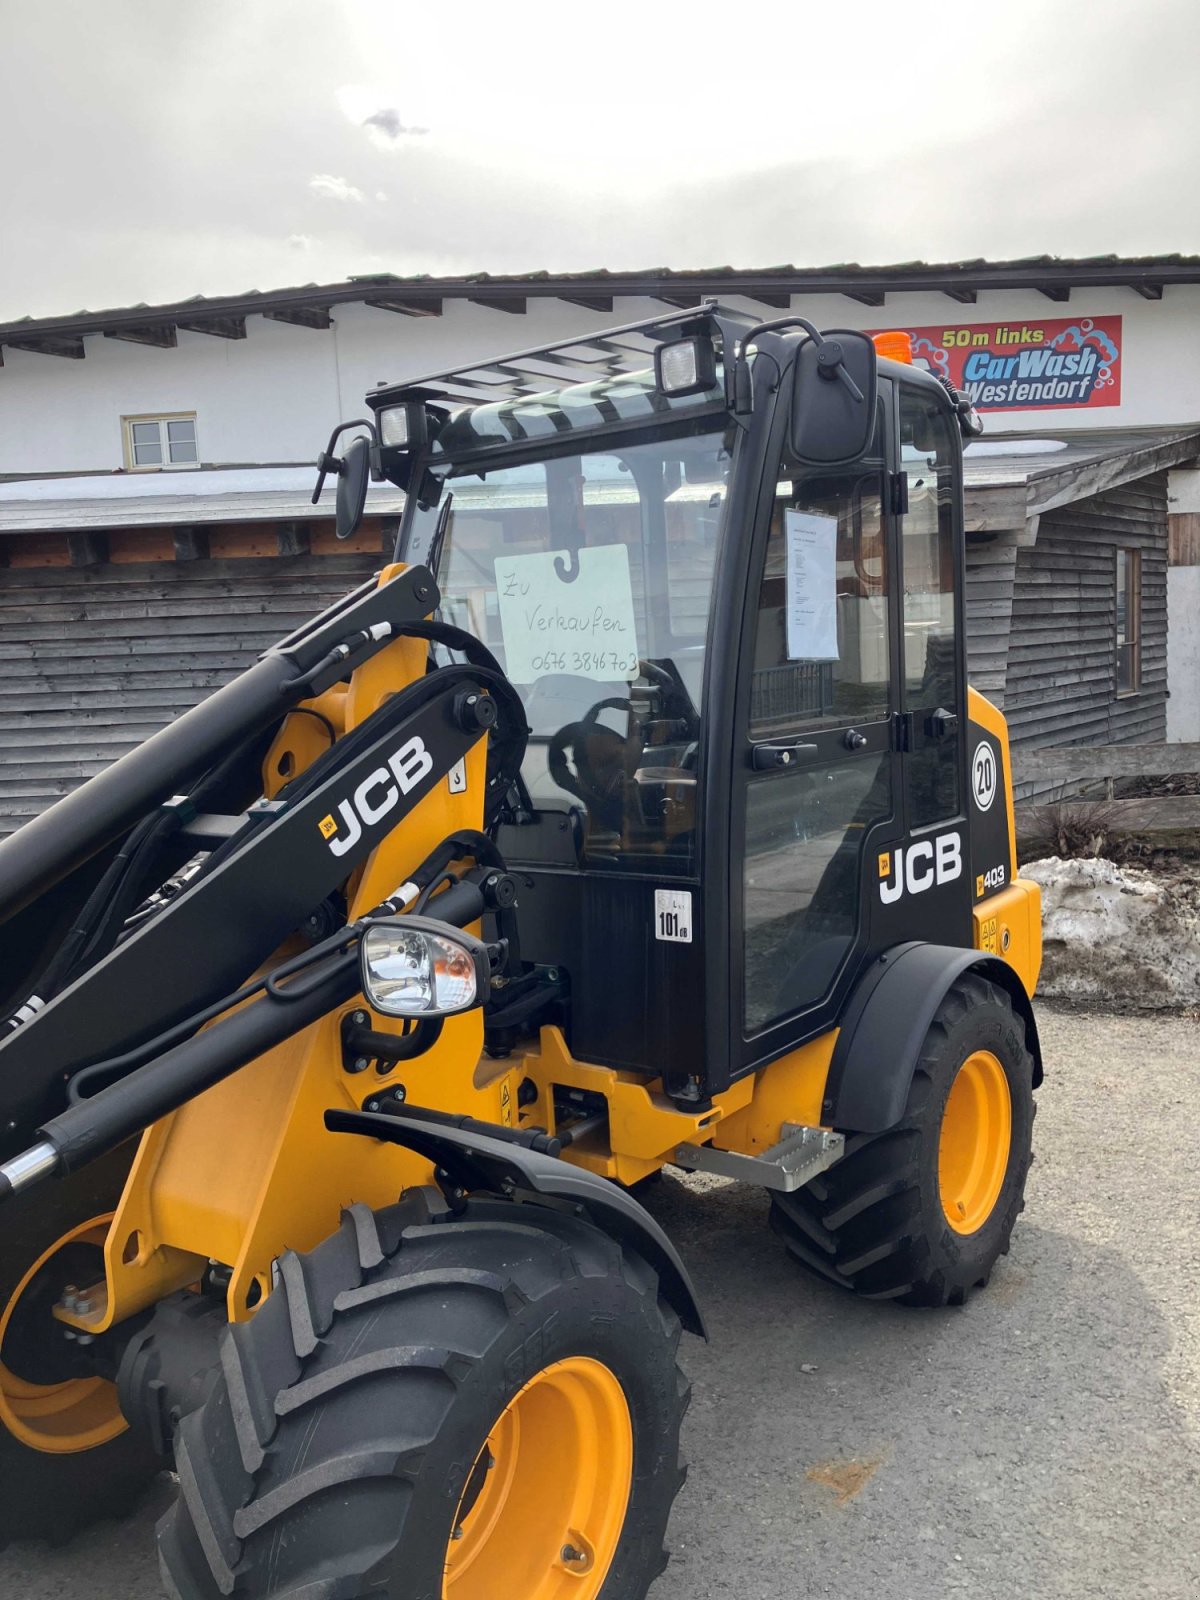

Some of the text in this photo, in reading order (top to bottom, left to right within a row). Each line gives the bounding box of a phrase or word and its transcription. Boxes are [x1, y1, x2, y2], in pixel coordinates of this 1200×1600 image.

[942, 326, 1044, 347] 50m links
[966, 348, 1097, 380] CarWash
[965, 376, 1090, 402] Westendorf
[503, 573, 530, 596] Zu
[524, 604, 626, 636] Verkaufen
[531, 652, 566, 670] 0676
[976, 758, 992, 796] 20
[328, 735, 434, 857] JCB
[879, 831, 962, 905] JCB
[984, 864, 1005, 888] 403
[659, 911, 678, 937] 101
